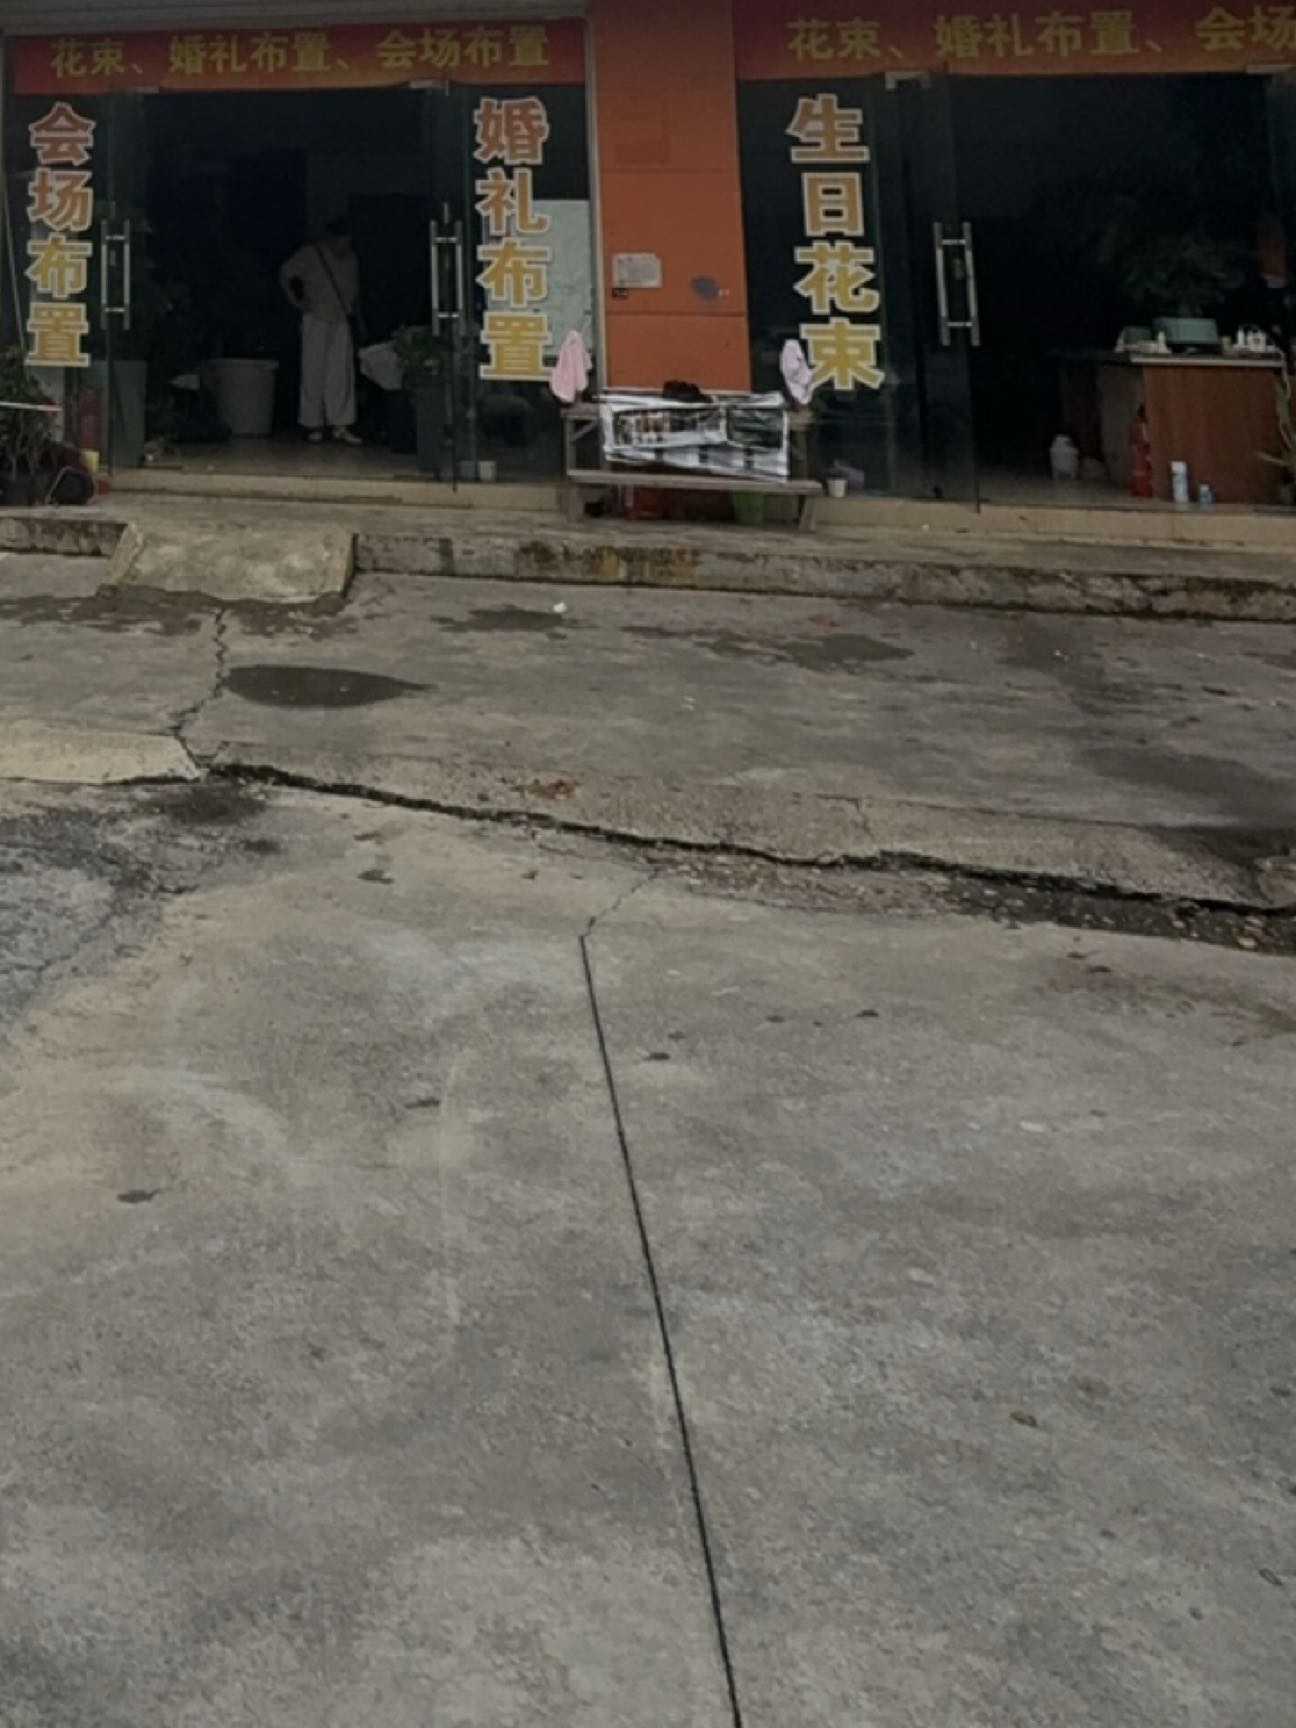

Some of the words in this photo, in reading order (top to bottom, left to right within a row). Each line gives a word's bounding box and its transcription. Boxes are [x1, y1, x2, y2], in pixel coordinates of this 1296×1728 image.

[24, 101, 96, 367] 会场布置
[473, 96, 552, 381] 婚礼布置
[785, 93, 884, 390] 生日花束
